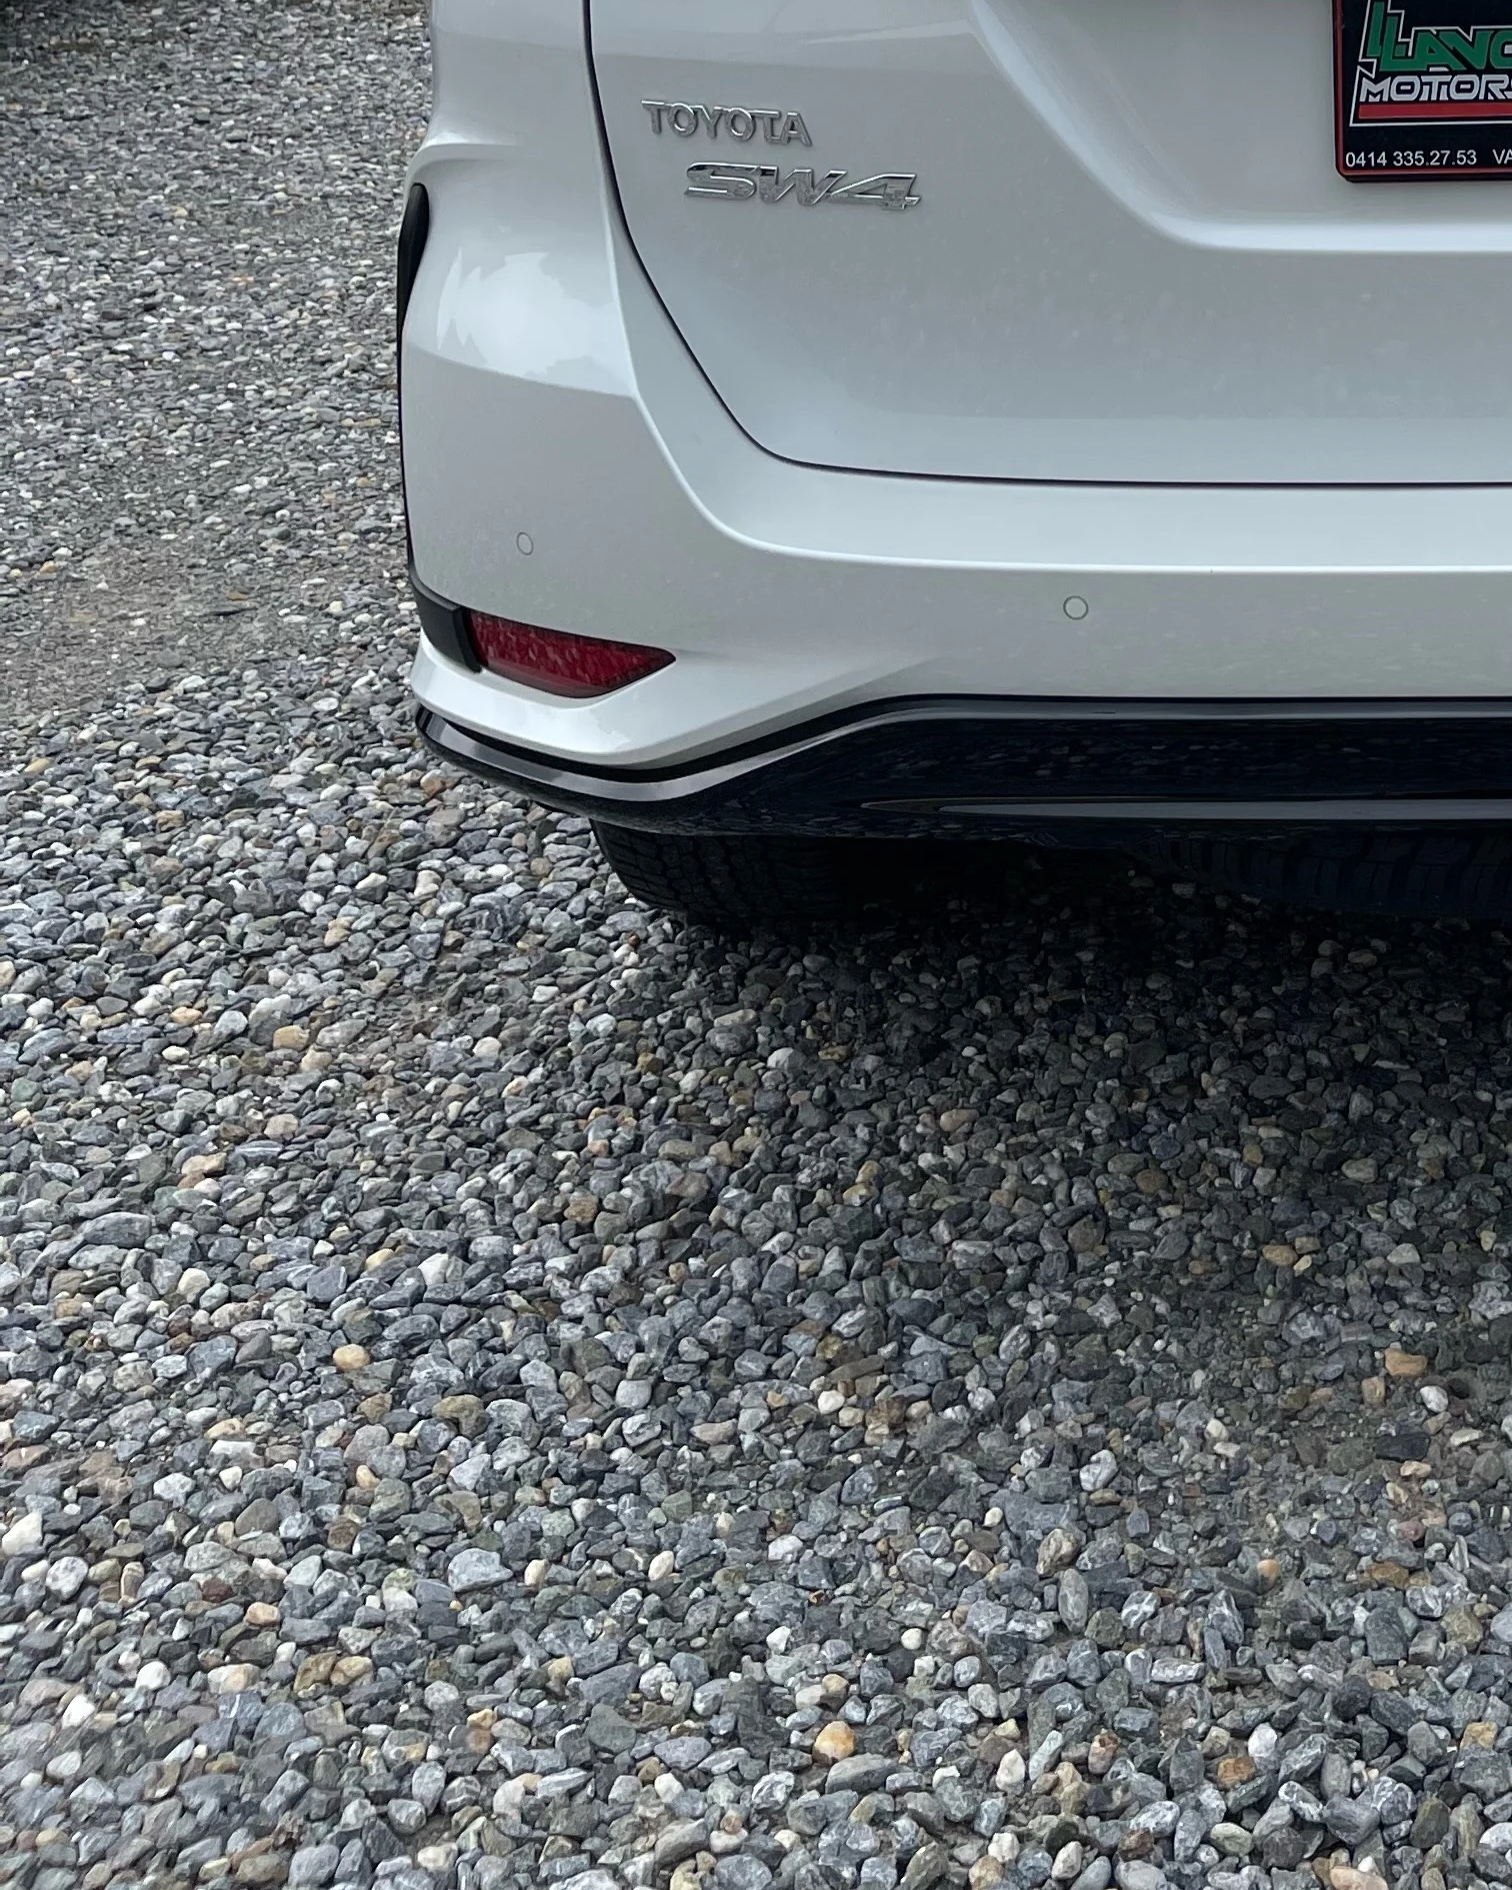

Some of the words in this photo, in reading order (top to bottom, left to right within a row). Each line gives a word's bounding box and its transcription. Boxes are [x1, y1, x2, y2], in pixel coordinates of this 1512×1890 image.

[640, 98, 813, 148] TOYOTA
[1344, 151, 1388, 169] 0414
[1392, 149, 1478, 167] 335.27.53
[683, 161, 922, 211] SW4
